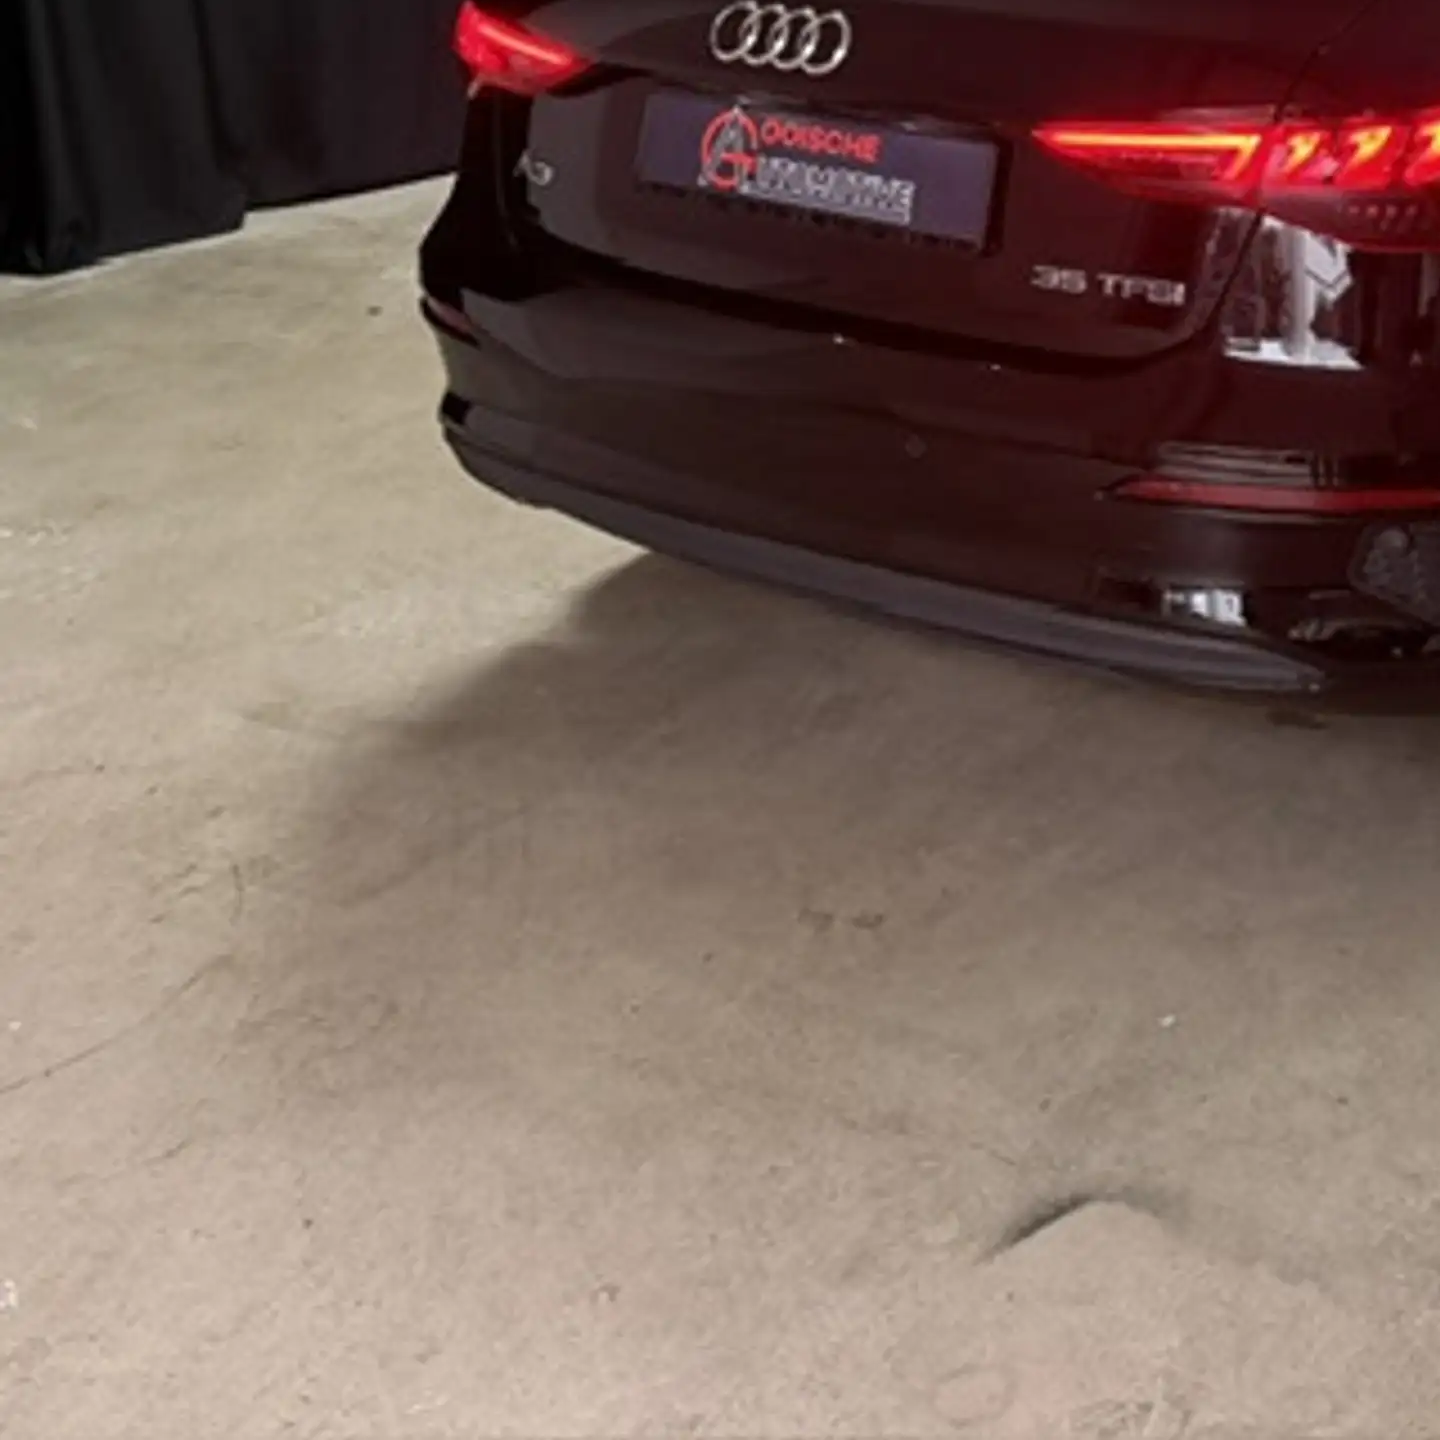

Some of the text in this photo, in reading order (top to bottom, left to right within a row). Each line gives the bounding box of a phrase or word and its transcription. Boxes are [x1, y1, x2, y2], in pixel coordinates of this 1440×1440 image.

[512, 149, 553, 186] A3
[1031, 264, 1185, 306] 35 TFSI
